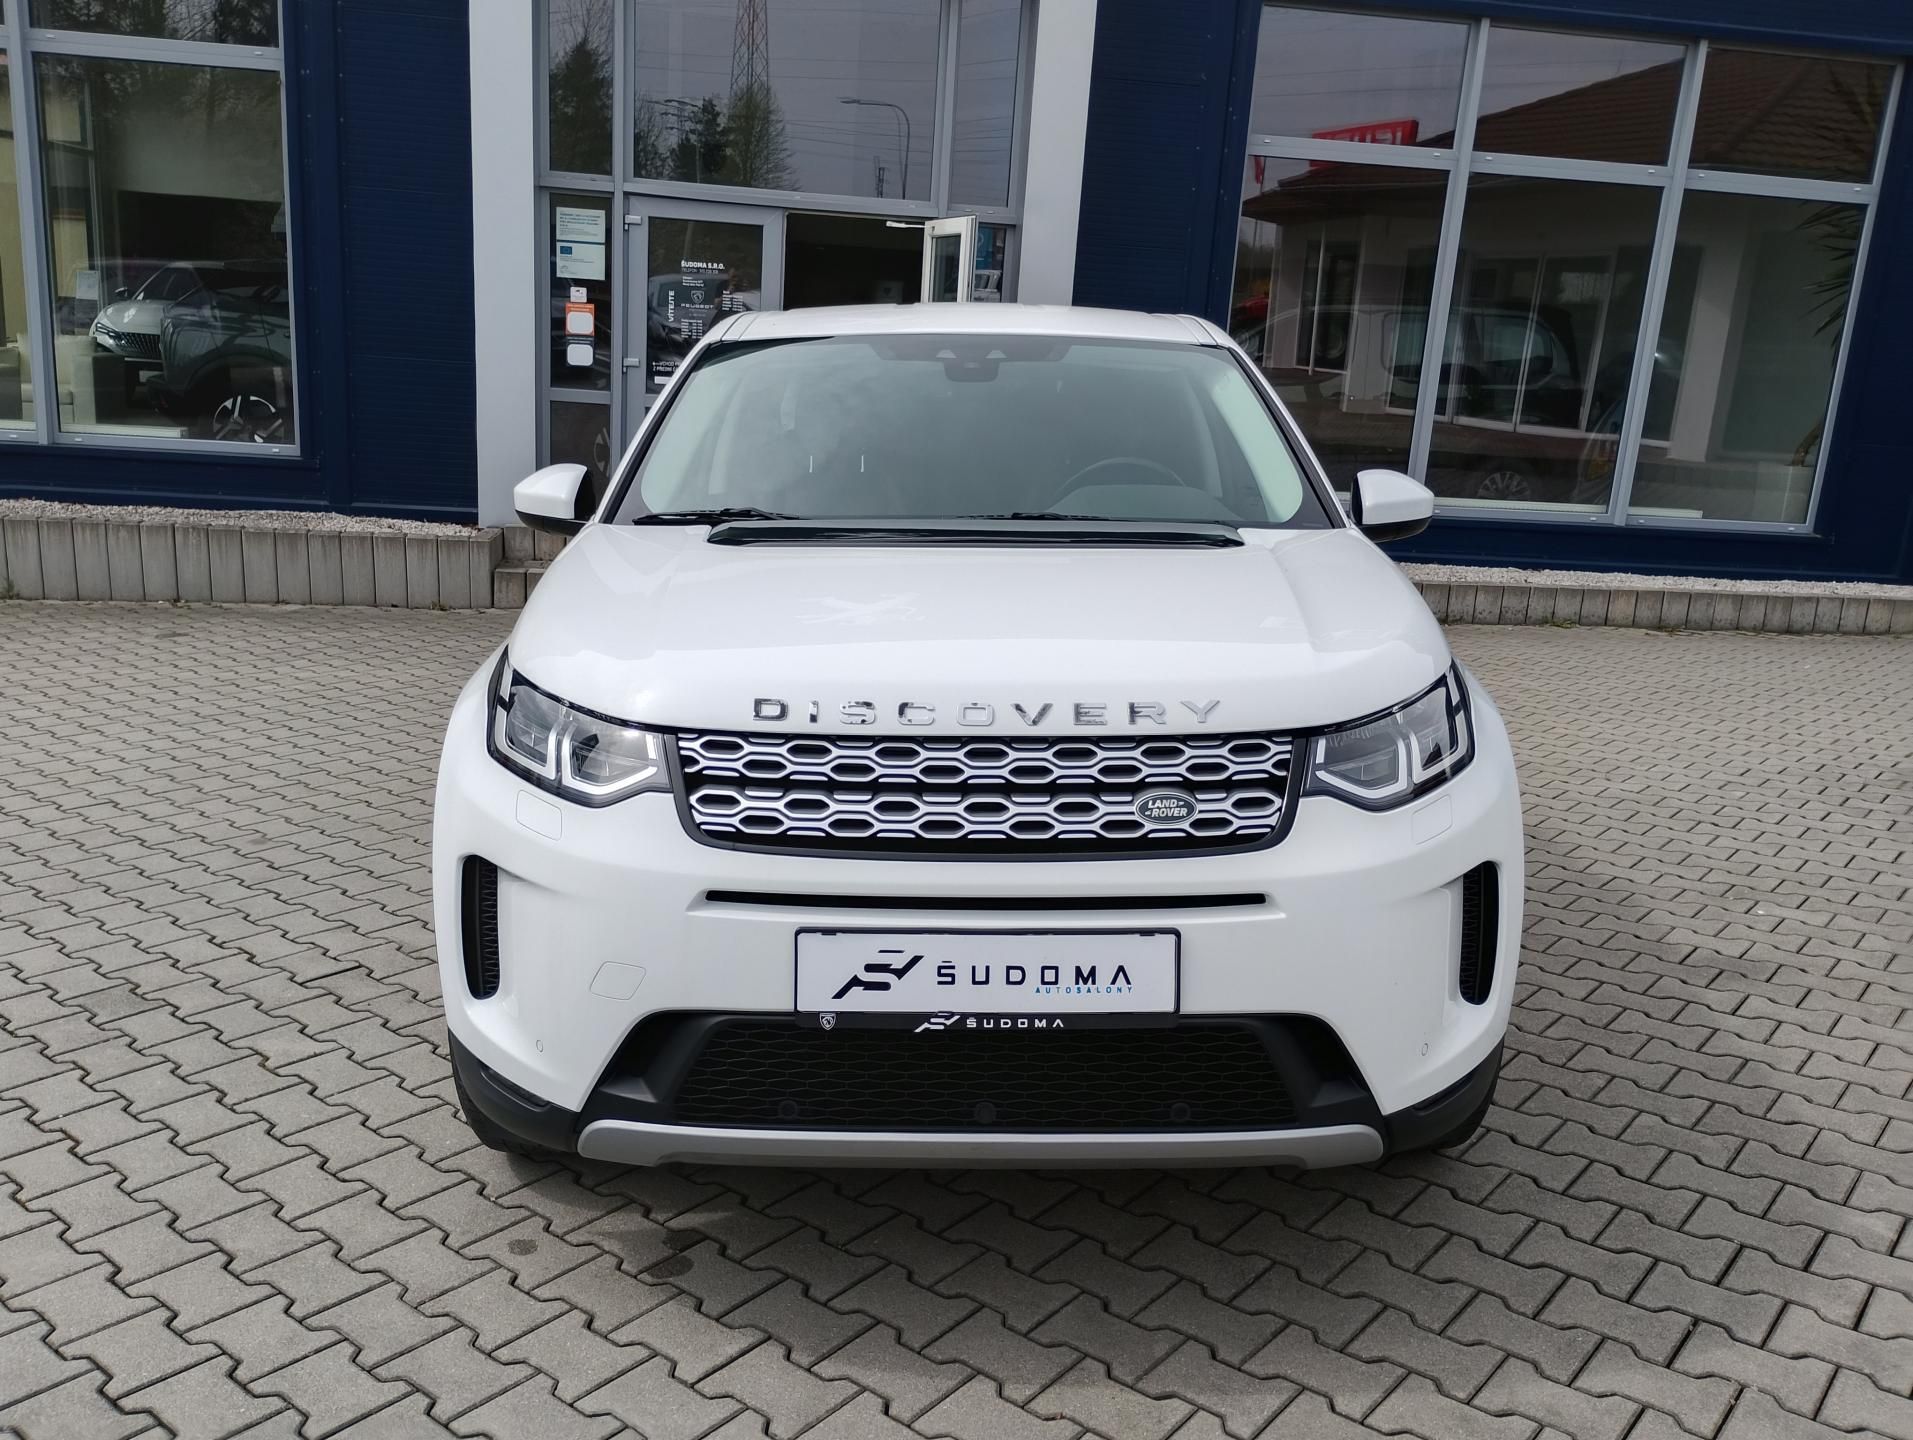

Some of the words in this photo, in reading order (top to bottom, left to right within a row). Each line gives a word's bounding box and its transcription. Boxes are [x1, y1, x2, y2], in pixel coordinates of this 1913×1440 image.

[752, 698, 1220, 727] DISCOVERY
[1148, 799, 1177, 809] LAND
[1151, 808, 1188, 818] ROVER
[1035, 986, 1133, 994] AUTOSALONY
